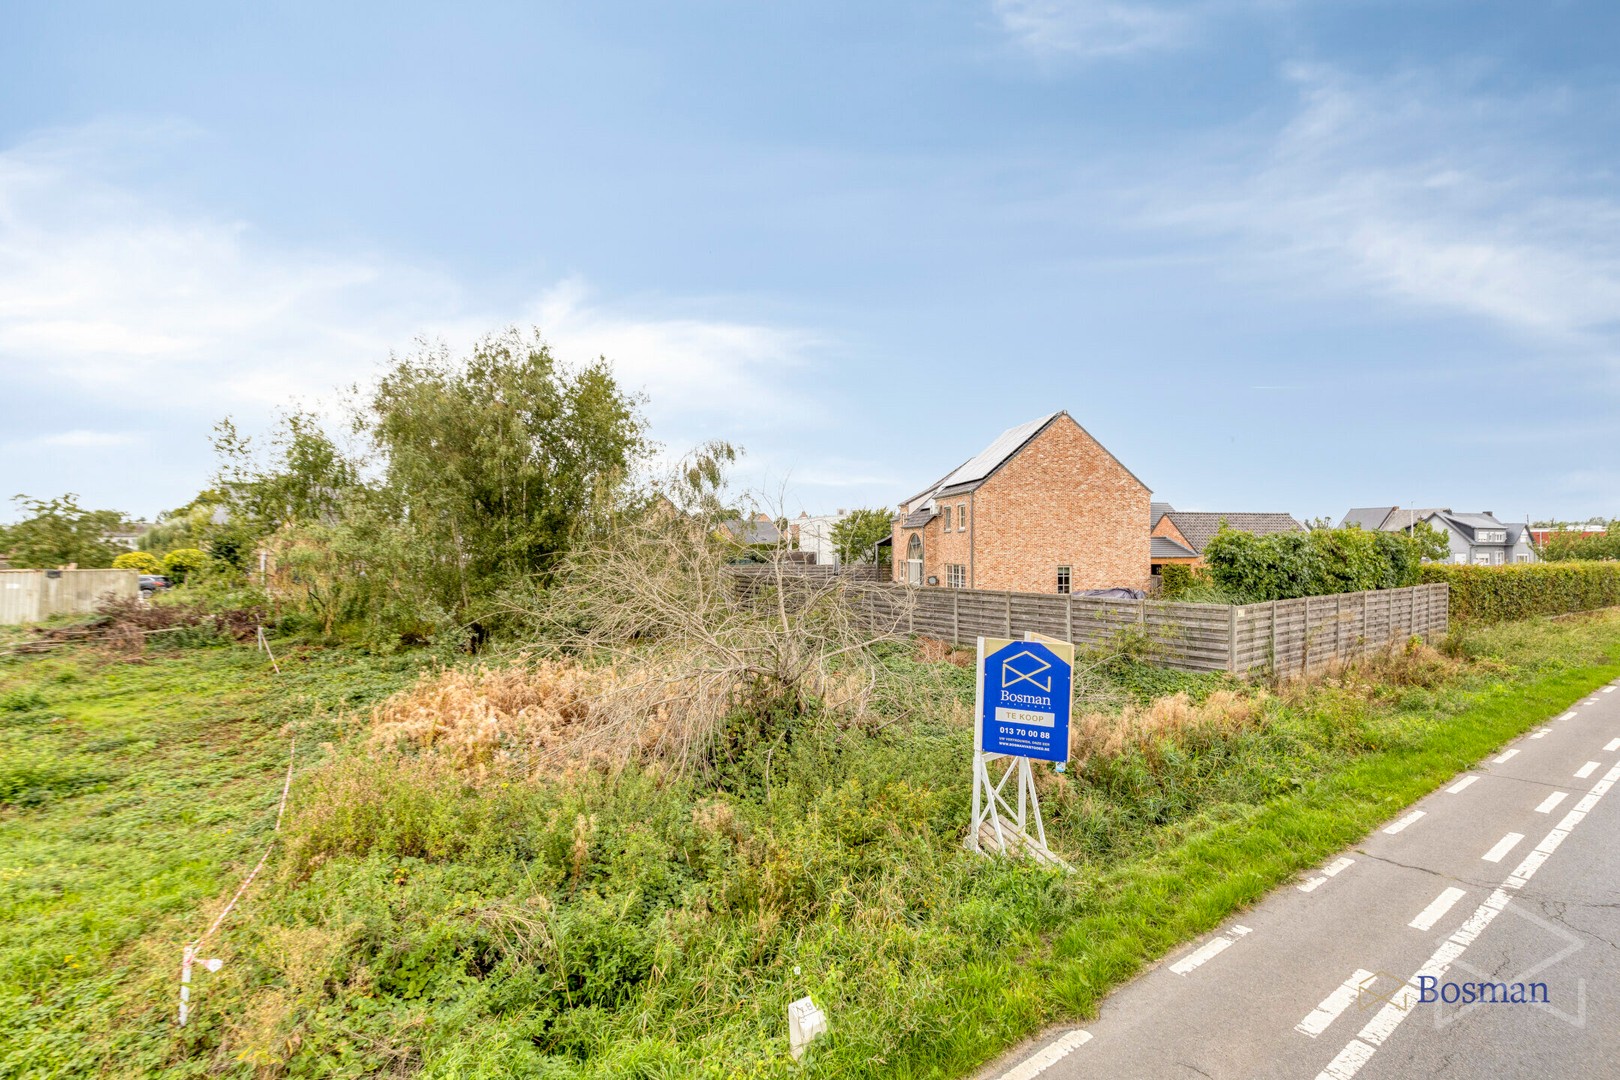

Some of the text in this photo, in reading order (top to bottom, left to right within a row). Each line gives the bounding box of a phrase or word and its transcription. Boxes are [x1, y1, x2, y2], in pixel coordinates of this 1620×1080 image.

[1000, 689, 1051, 706] Bosman
[1005, 711, 1044, 722] TE KOOP
[999, 726, 1050, 739] 013 70 00 88
